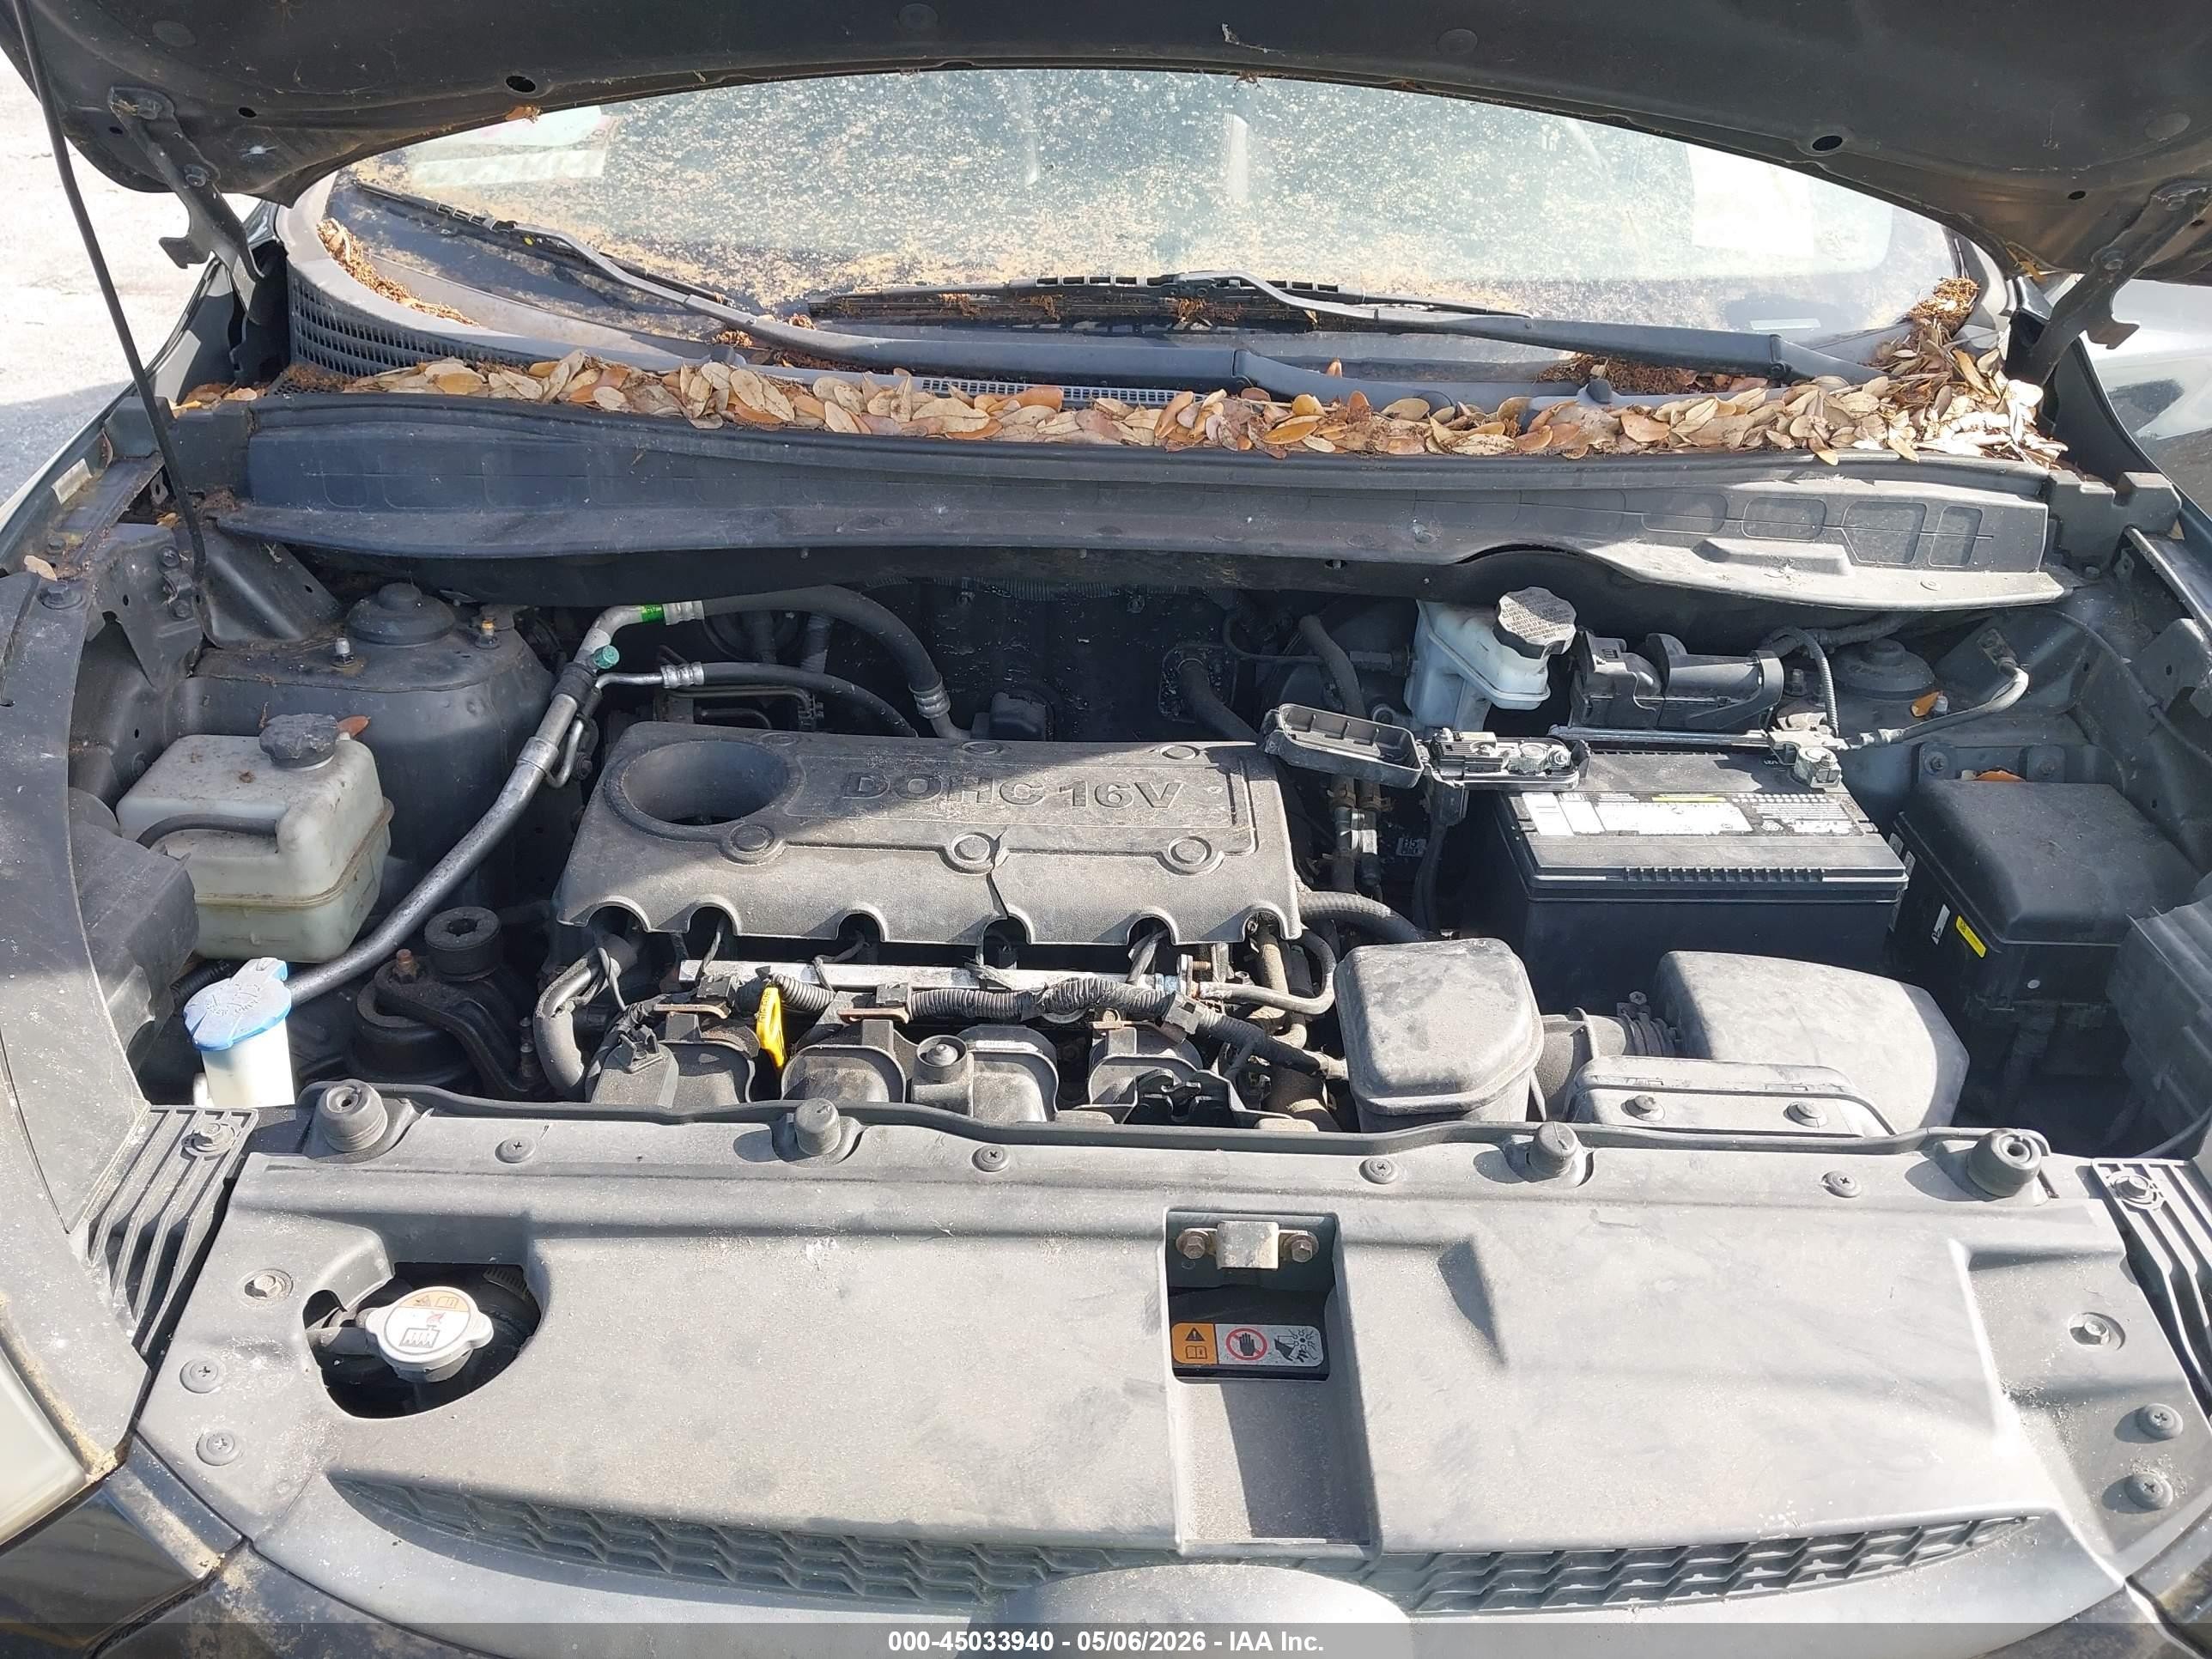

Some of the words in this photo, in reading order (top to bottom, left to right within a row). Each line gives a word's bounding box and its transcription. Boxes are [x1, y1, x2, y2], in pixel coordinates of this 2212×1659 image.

[842, 772, 1045, 806] DOHC
[1059, 778, 1183, 809] 16V
[757, 1006, 769, 1023] OIL
